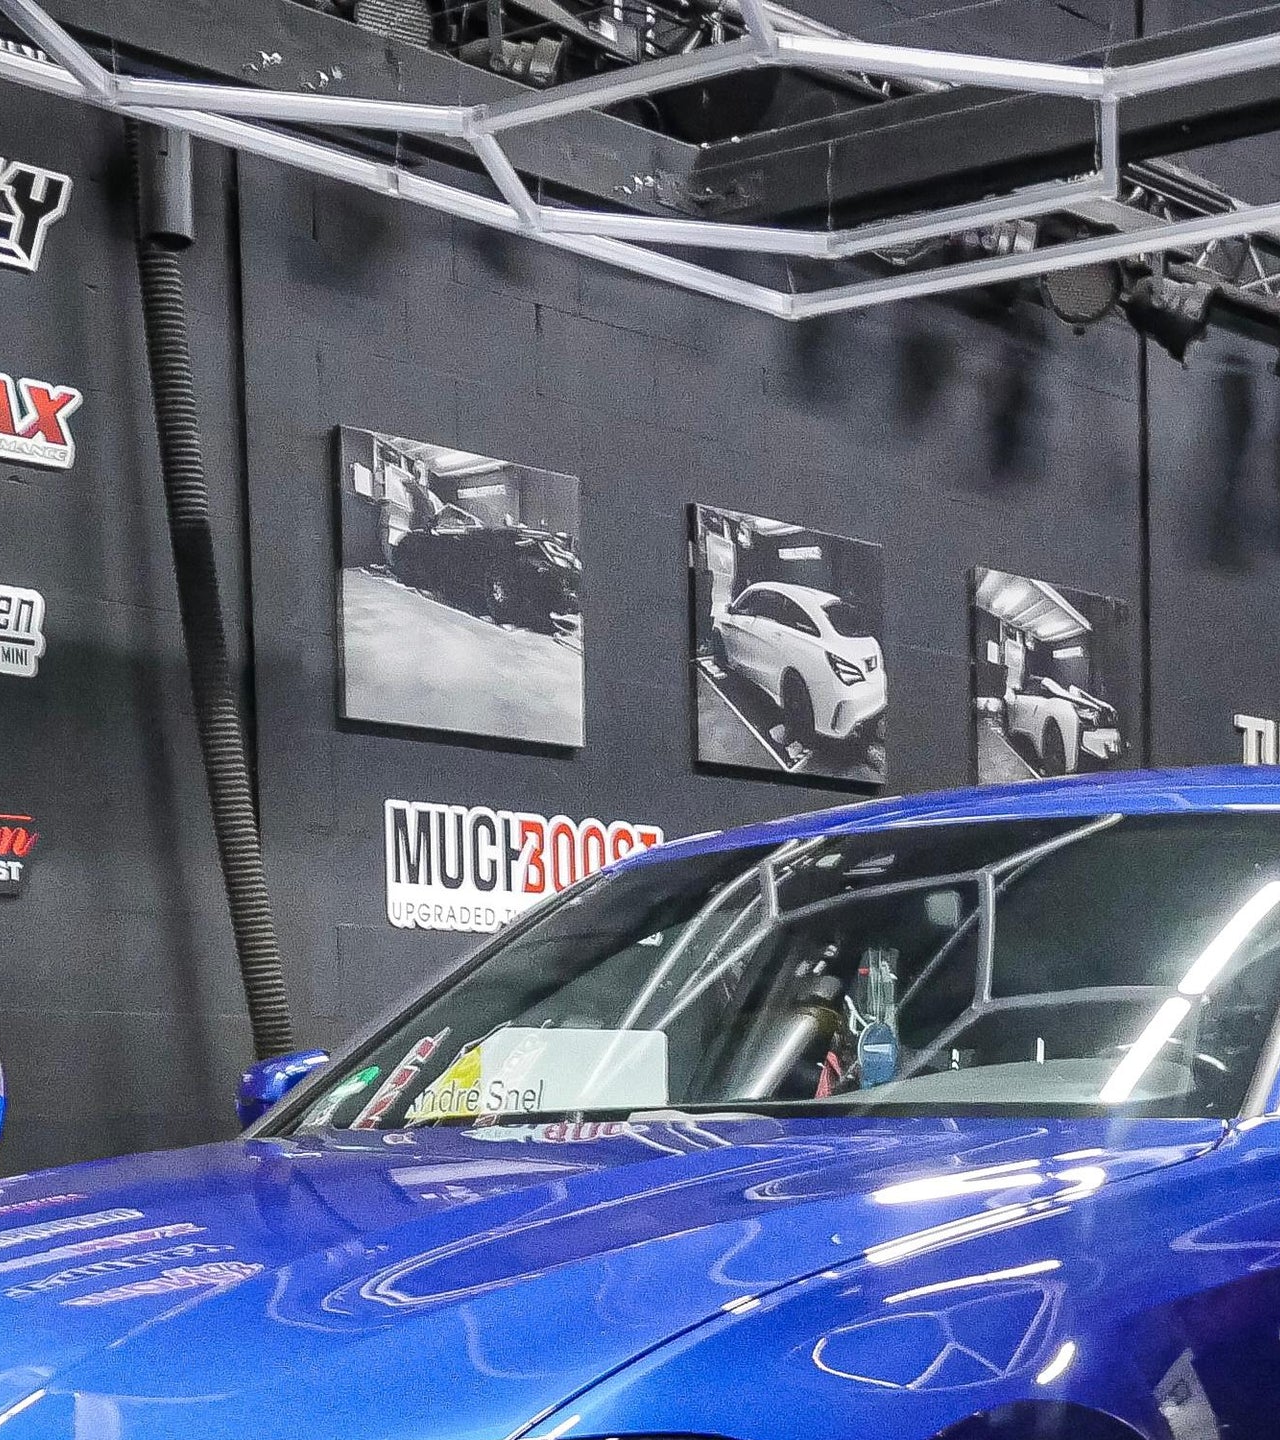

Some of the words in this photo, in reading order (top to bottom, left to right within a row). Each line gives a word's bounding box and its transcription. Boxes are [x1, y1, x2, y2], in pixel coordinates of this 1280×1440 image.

[1, 645, 29, 666] MINI
[391, 808, 658, 893] MUCHBOO
[392, 901, 496, 926] UPGRADED
[486, 1079, 544, 1112] Snel
